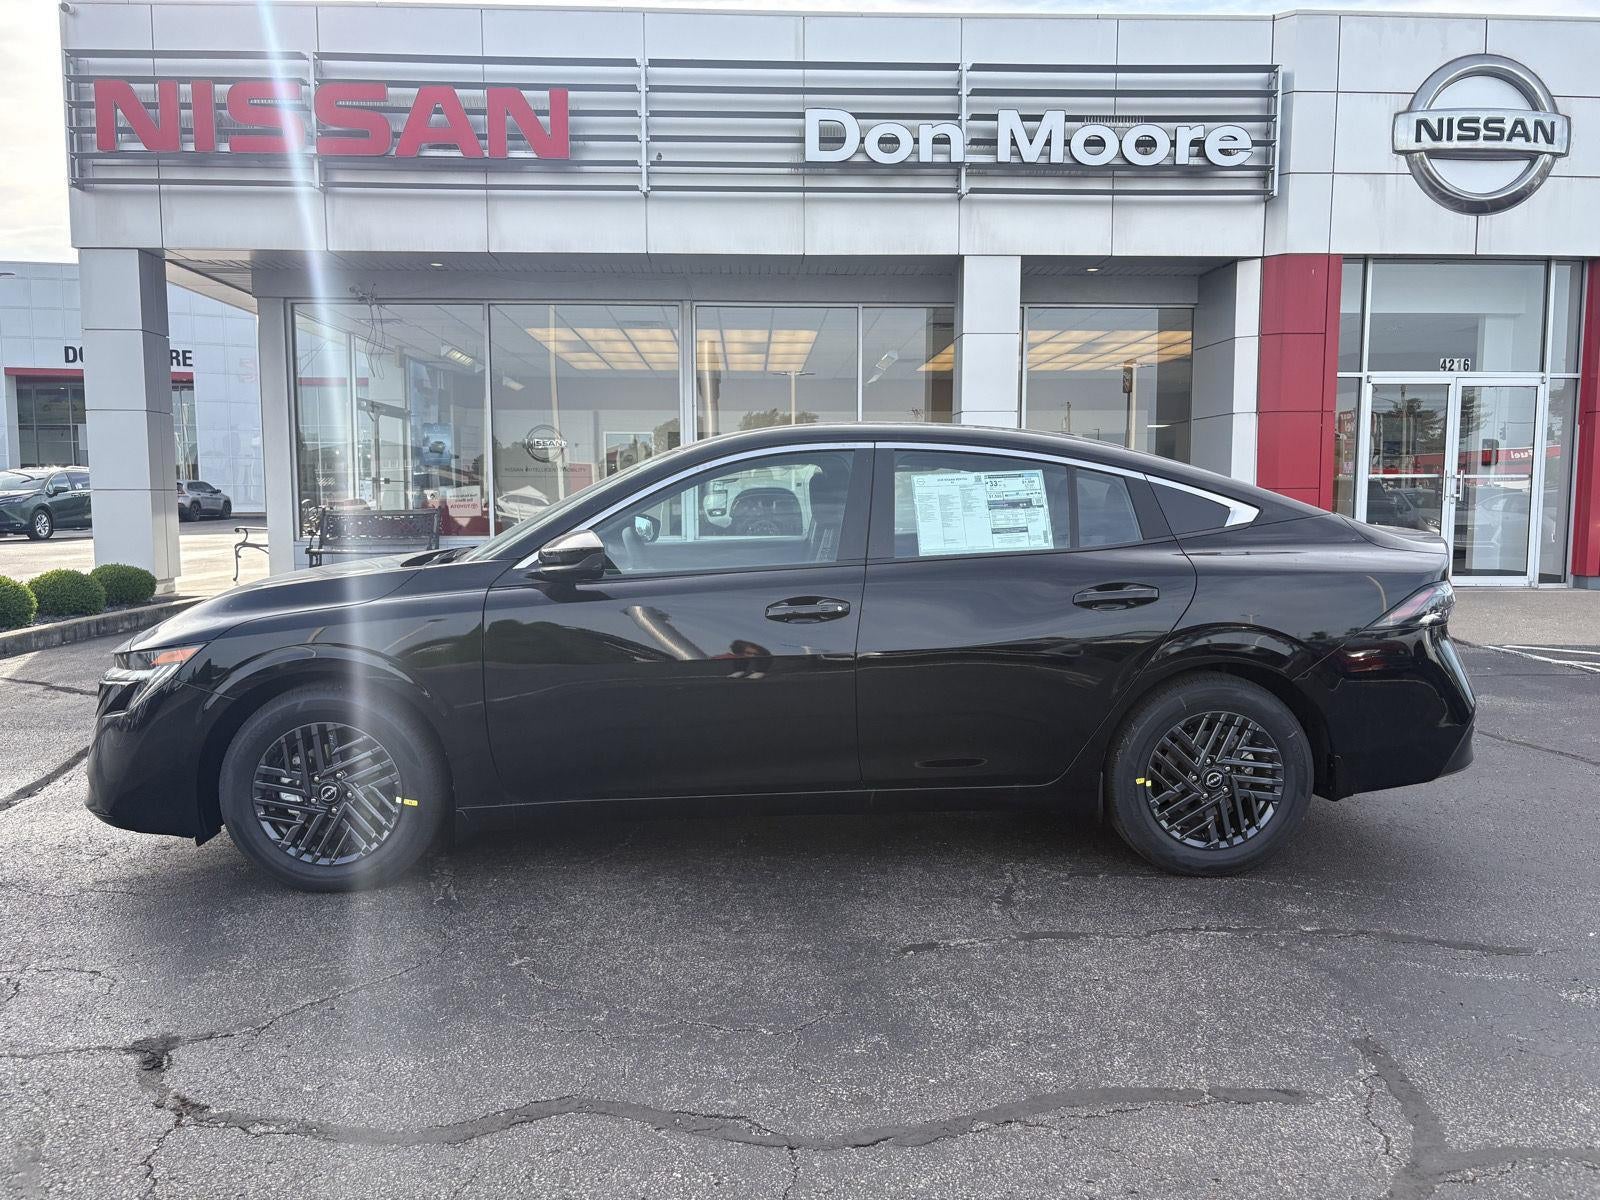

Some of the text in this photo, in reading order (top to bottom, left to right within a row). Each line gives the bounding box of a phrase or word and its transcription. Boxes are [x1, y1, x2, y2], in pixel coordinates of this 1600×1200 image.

[93, 79, 571, 160] NISSAN
[1414, 116, 1556, 145] NISSAN
[804, 108, 1254, 166] Don Moore
[1440, 358, 1470, 371] 4216
[526, 438, 563, 448] NISSAN
